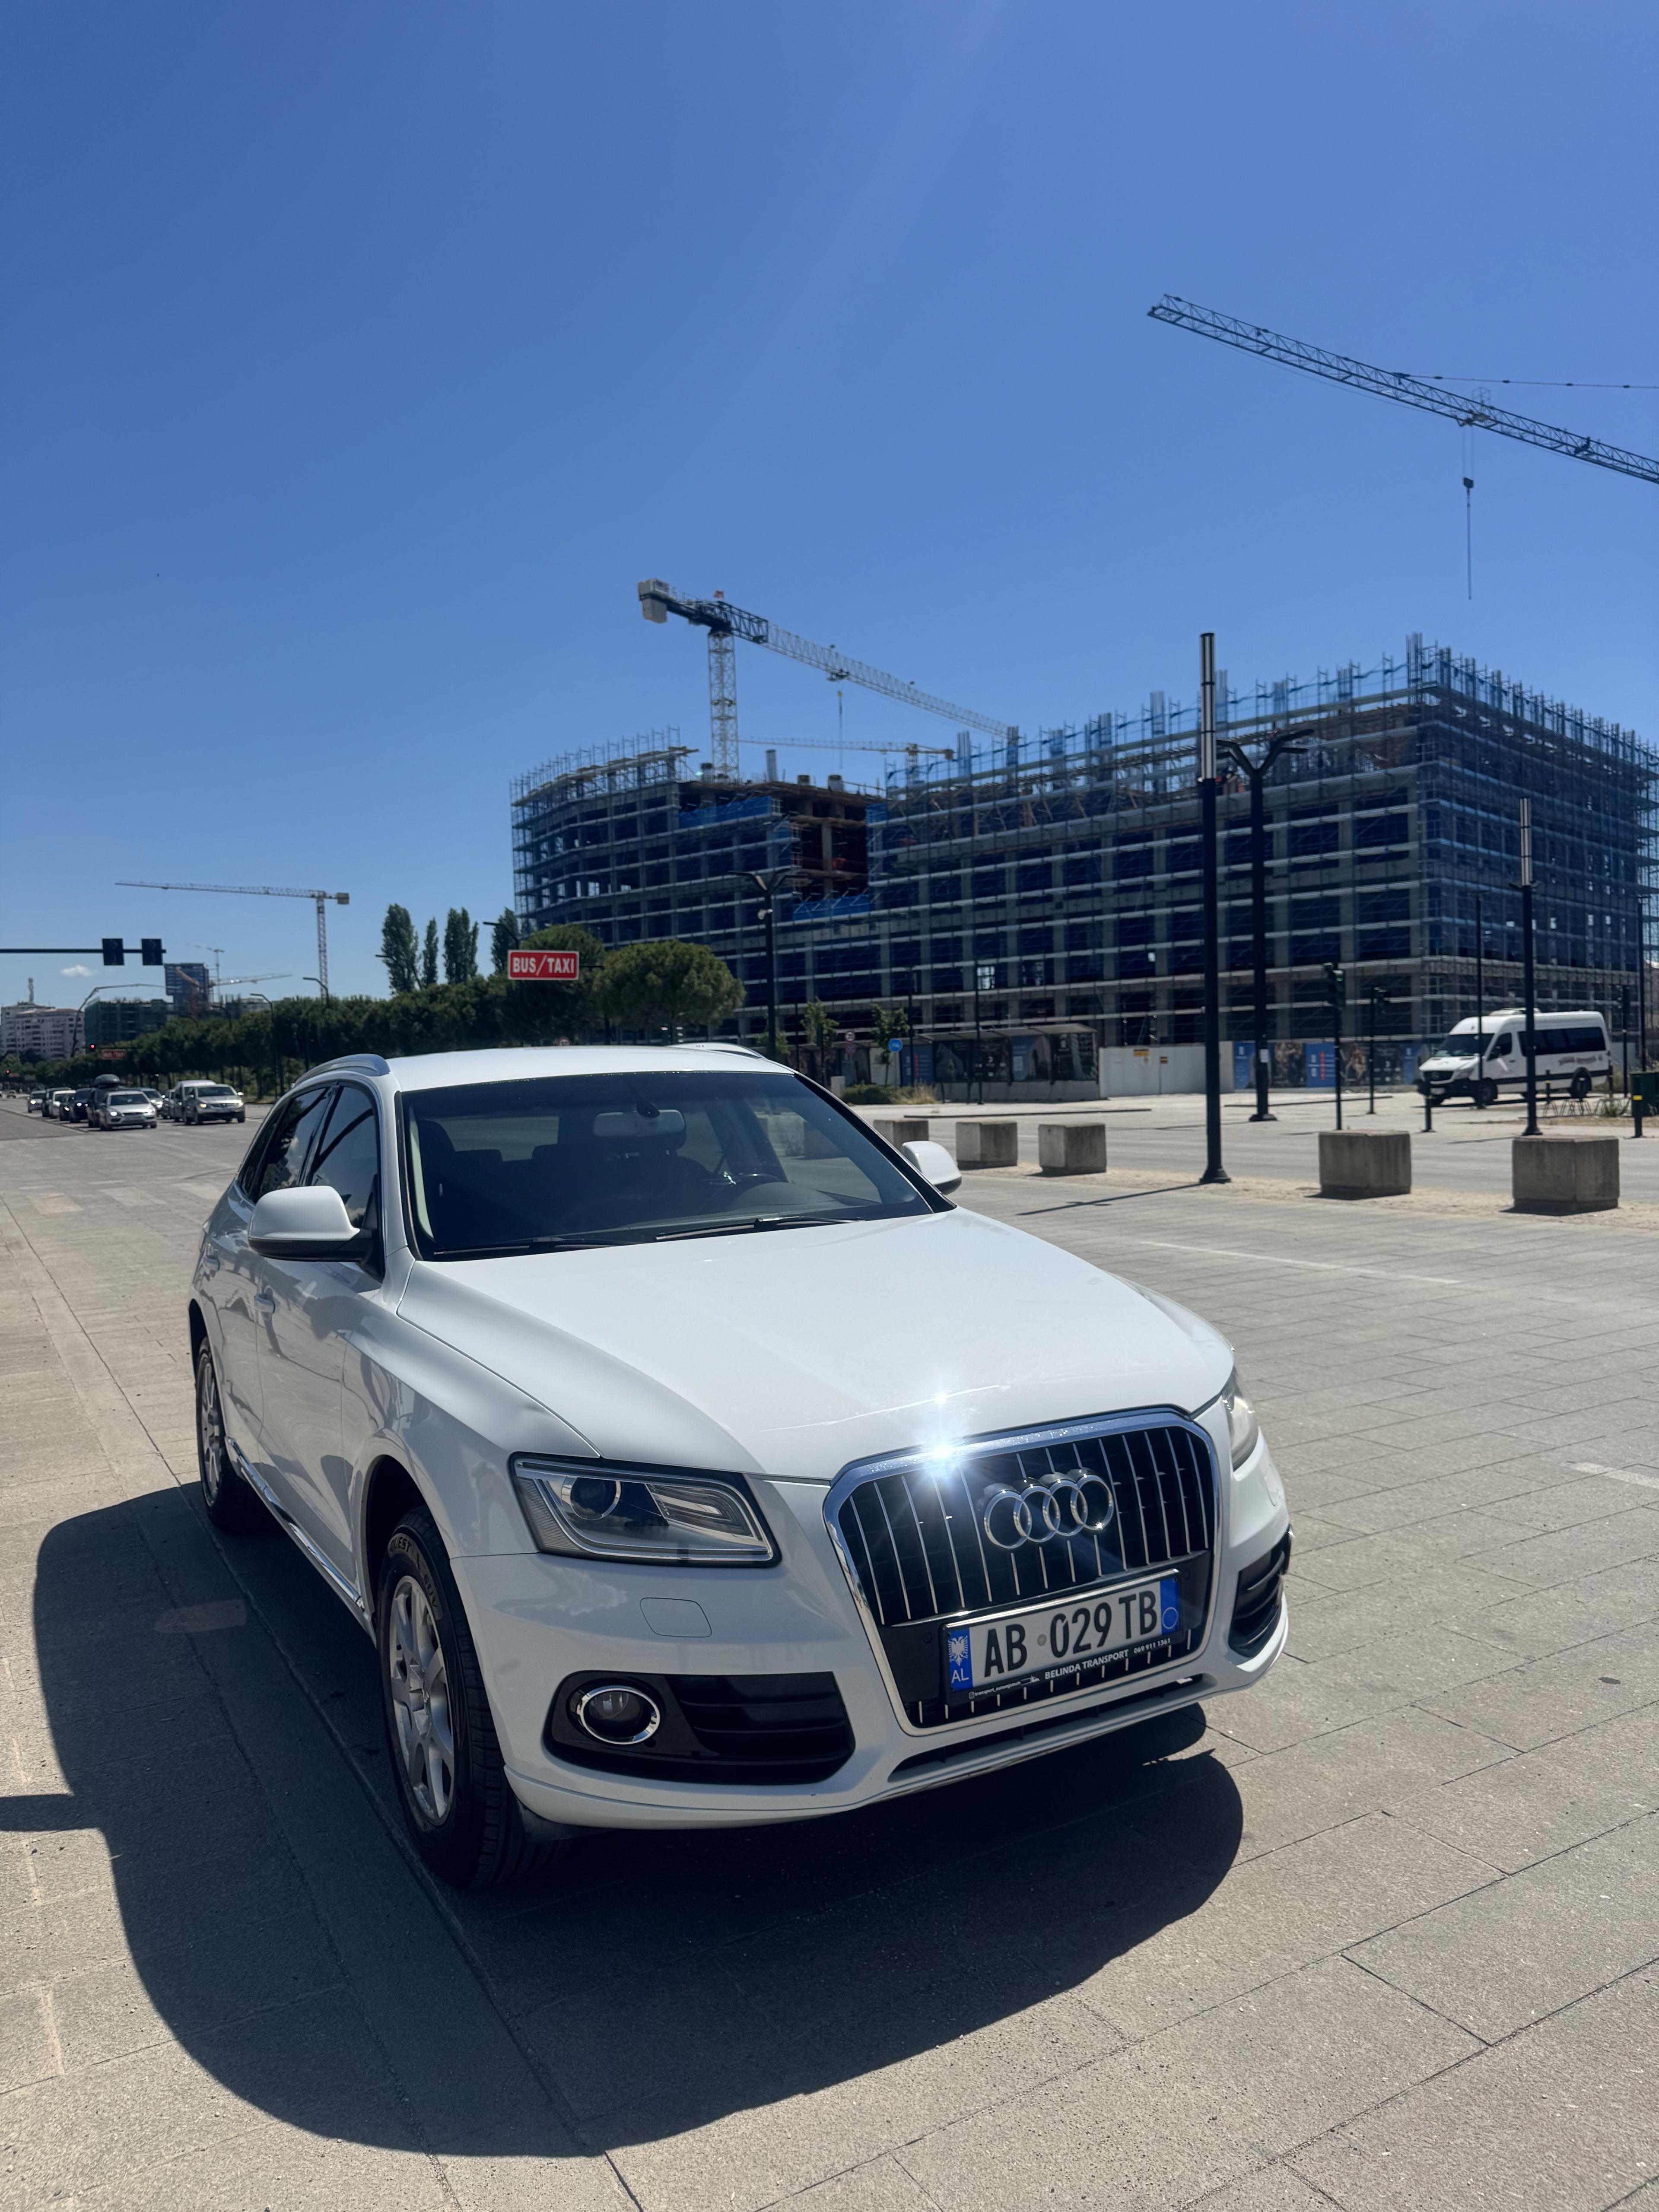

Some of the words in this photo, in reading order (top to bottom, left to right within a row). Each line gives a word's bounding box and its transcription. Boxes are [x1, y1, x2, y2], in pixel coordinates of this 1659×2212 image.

[513, 955, 574, 976] BUS/TAXI
[984, 1624, 1027, 1678] AB
[1050, 1602, 1112, 1658] 029
[1119, 1590, 1158, 1640] TB
[951, 1668, 969, 1684] AL
[1045, 1663, 1081, 1680] BELINDA
[1081, 1649, 1129, 1669] TRANSPORT
